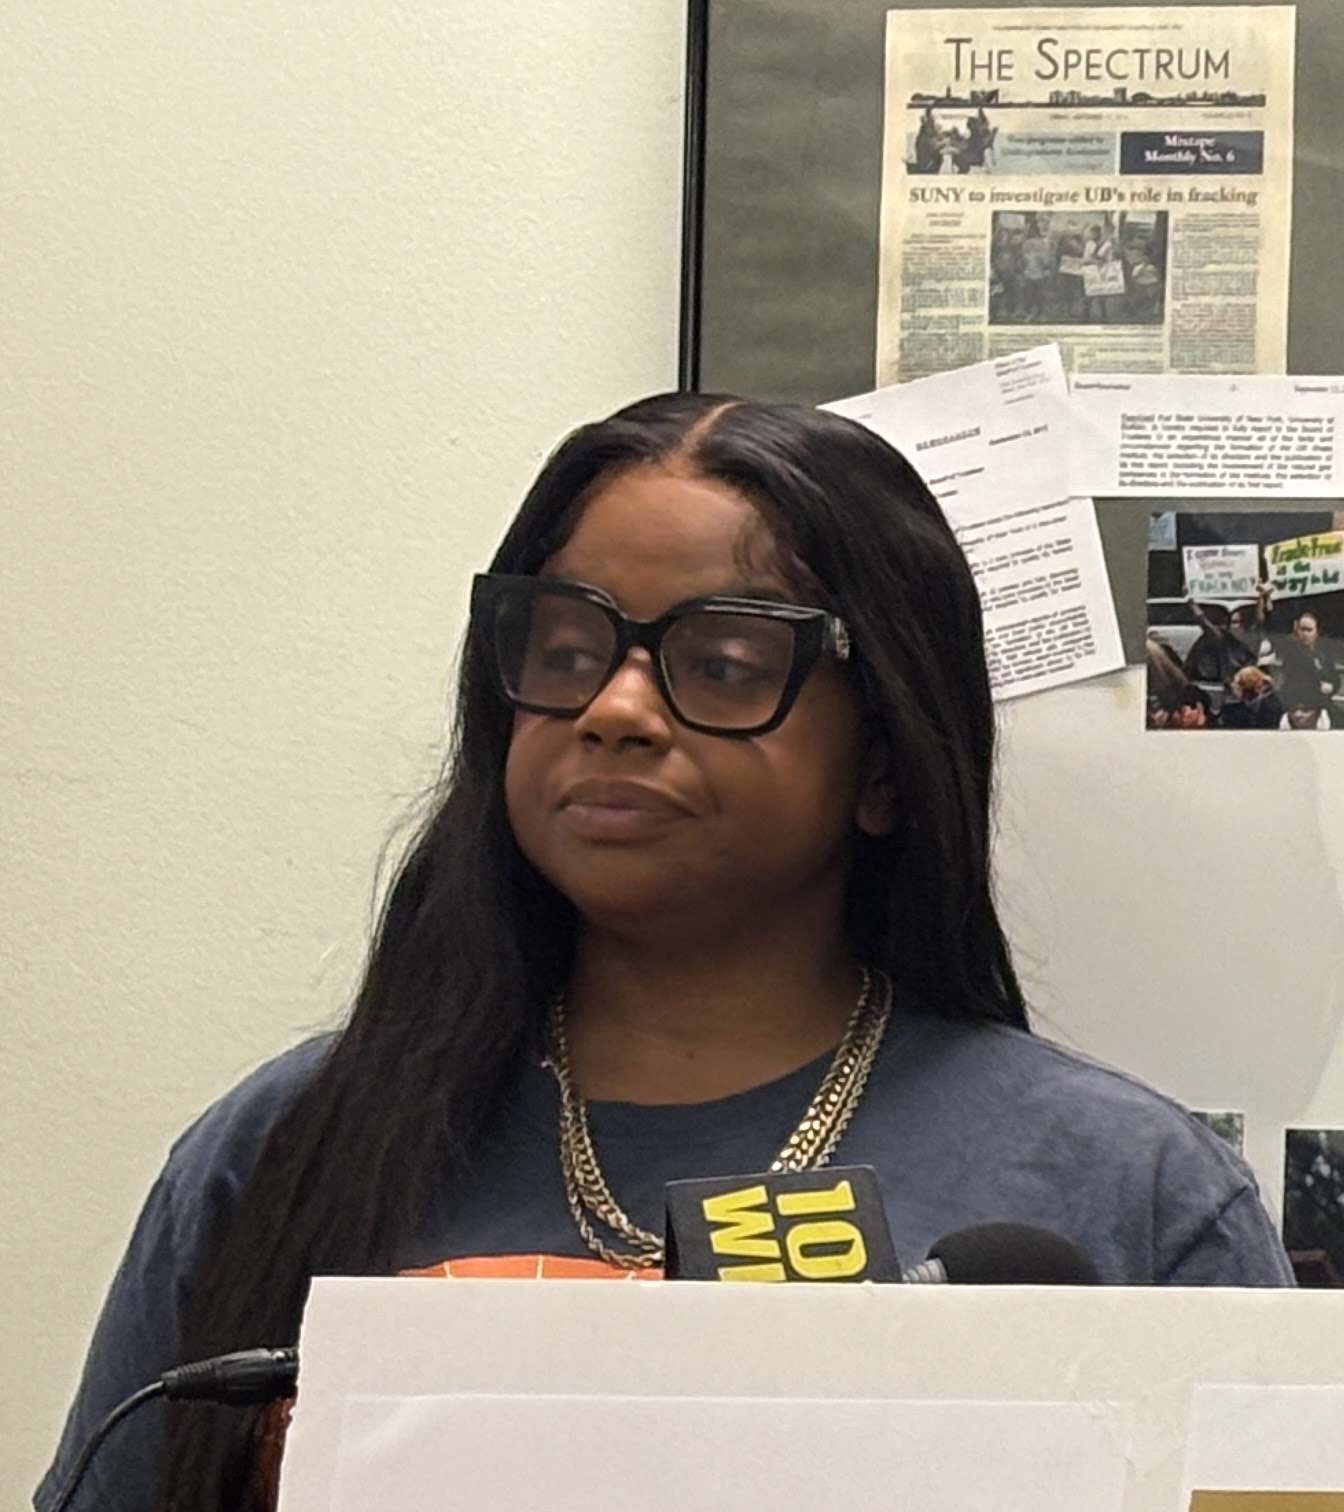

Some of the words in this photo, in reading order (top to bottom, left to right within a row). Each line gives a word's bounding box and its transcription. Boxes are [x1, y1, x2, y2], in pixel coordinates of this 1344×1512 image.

[1144, 149, 1196, 163] Monthly
[1200, 149, 1223, 161] No.
[1226, 150, 1235, 161] 6
[910, 188, 965, 202] SUNY
[969, 190, 985, 201] to
[990, 188, 1079, 207] investigate
[1084, 187, 1125, 201] UB's
[1130, 188, 1161, 201] role
[1167, 189, 1182, 201] in
[1188, 188, 1258, 207] fracking
[776, 1179, 868, 1278] 10
